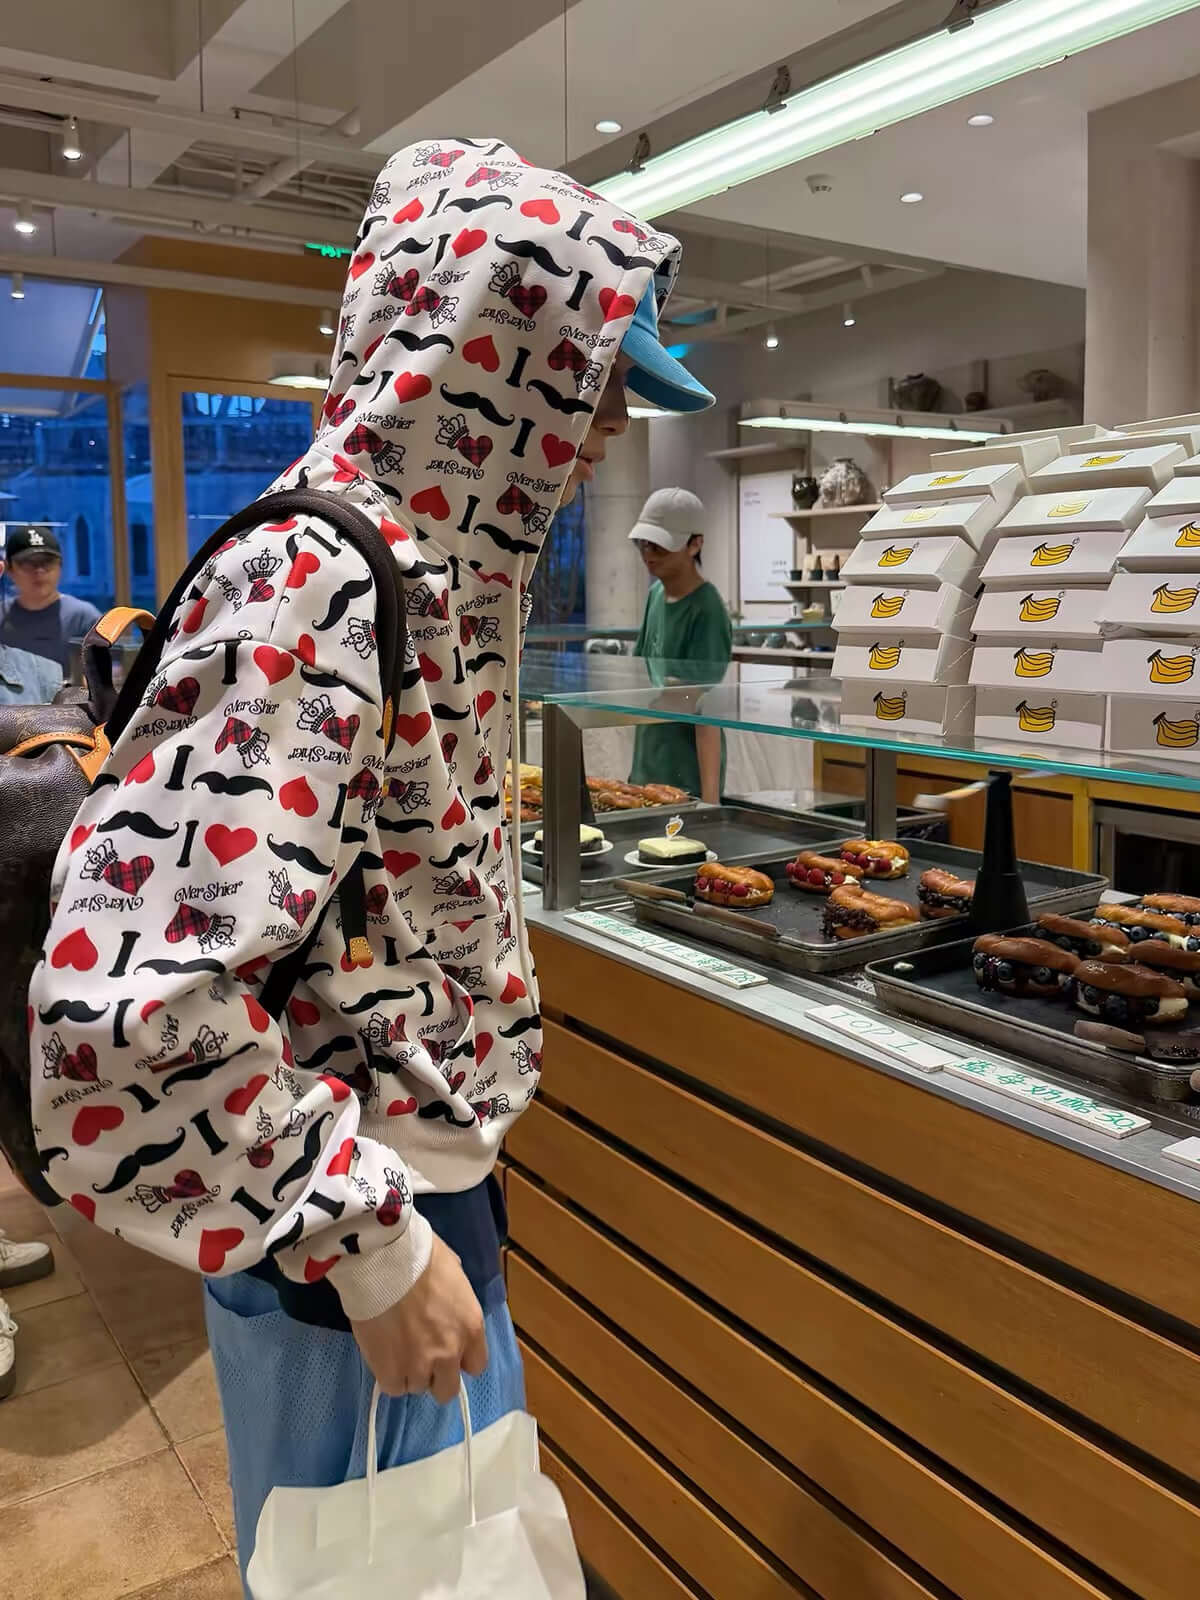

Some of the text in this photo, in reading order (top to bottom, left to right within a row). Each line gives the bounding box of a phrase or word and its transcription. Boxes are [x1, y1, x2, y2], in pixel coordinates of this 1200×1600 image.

[566, 210, 595, 241] I
[565, 270, 594, 311] I
[477, 307, 536, 332] MerShier
[505, 347, 531, 388] I
[509, 417, 536, 458] I
[426, 459, 485, 481] MerShier
[505, 471, 561, 493] MerShier
[457, 494, 481, 534] I
[303, 526, 342, 557] I
[224, 640, 242, 685] I
[224, 698, 279, 718] MerShier
[132, 715, 199, 741] MerShier
[164, 744, 195, 791] I
[328, 782, 348, 829] I
[176, 820, 200, 869] I
[68, 893, 144, 914] MerShier
[175, 881, 244, 902] MerShier
[108, 930, 142, 978] I
[382, 935, 401, 967] I
[416, 980, 435, 1017] I
[113, 998, 136, 1049] I
[831, 1010, 895, 1036] TOP
[119, 1083, 161, 1114] I
[190, 1109, 229, 1156] I
[230, 1186, 276, 1225] I
[302, 1190, 346, 1221] I
